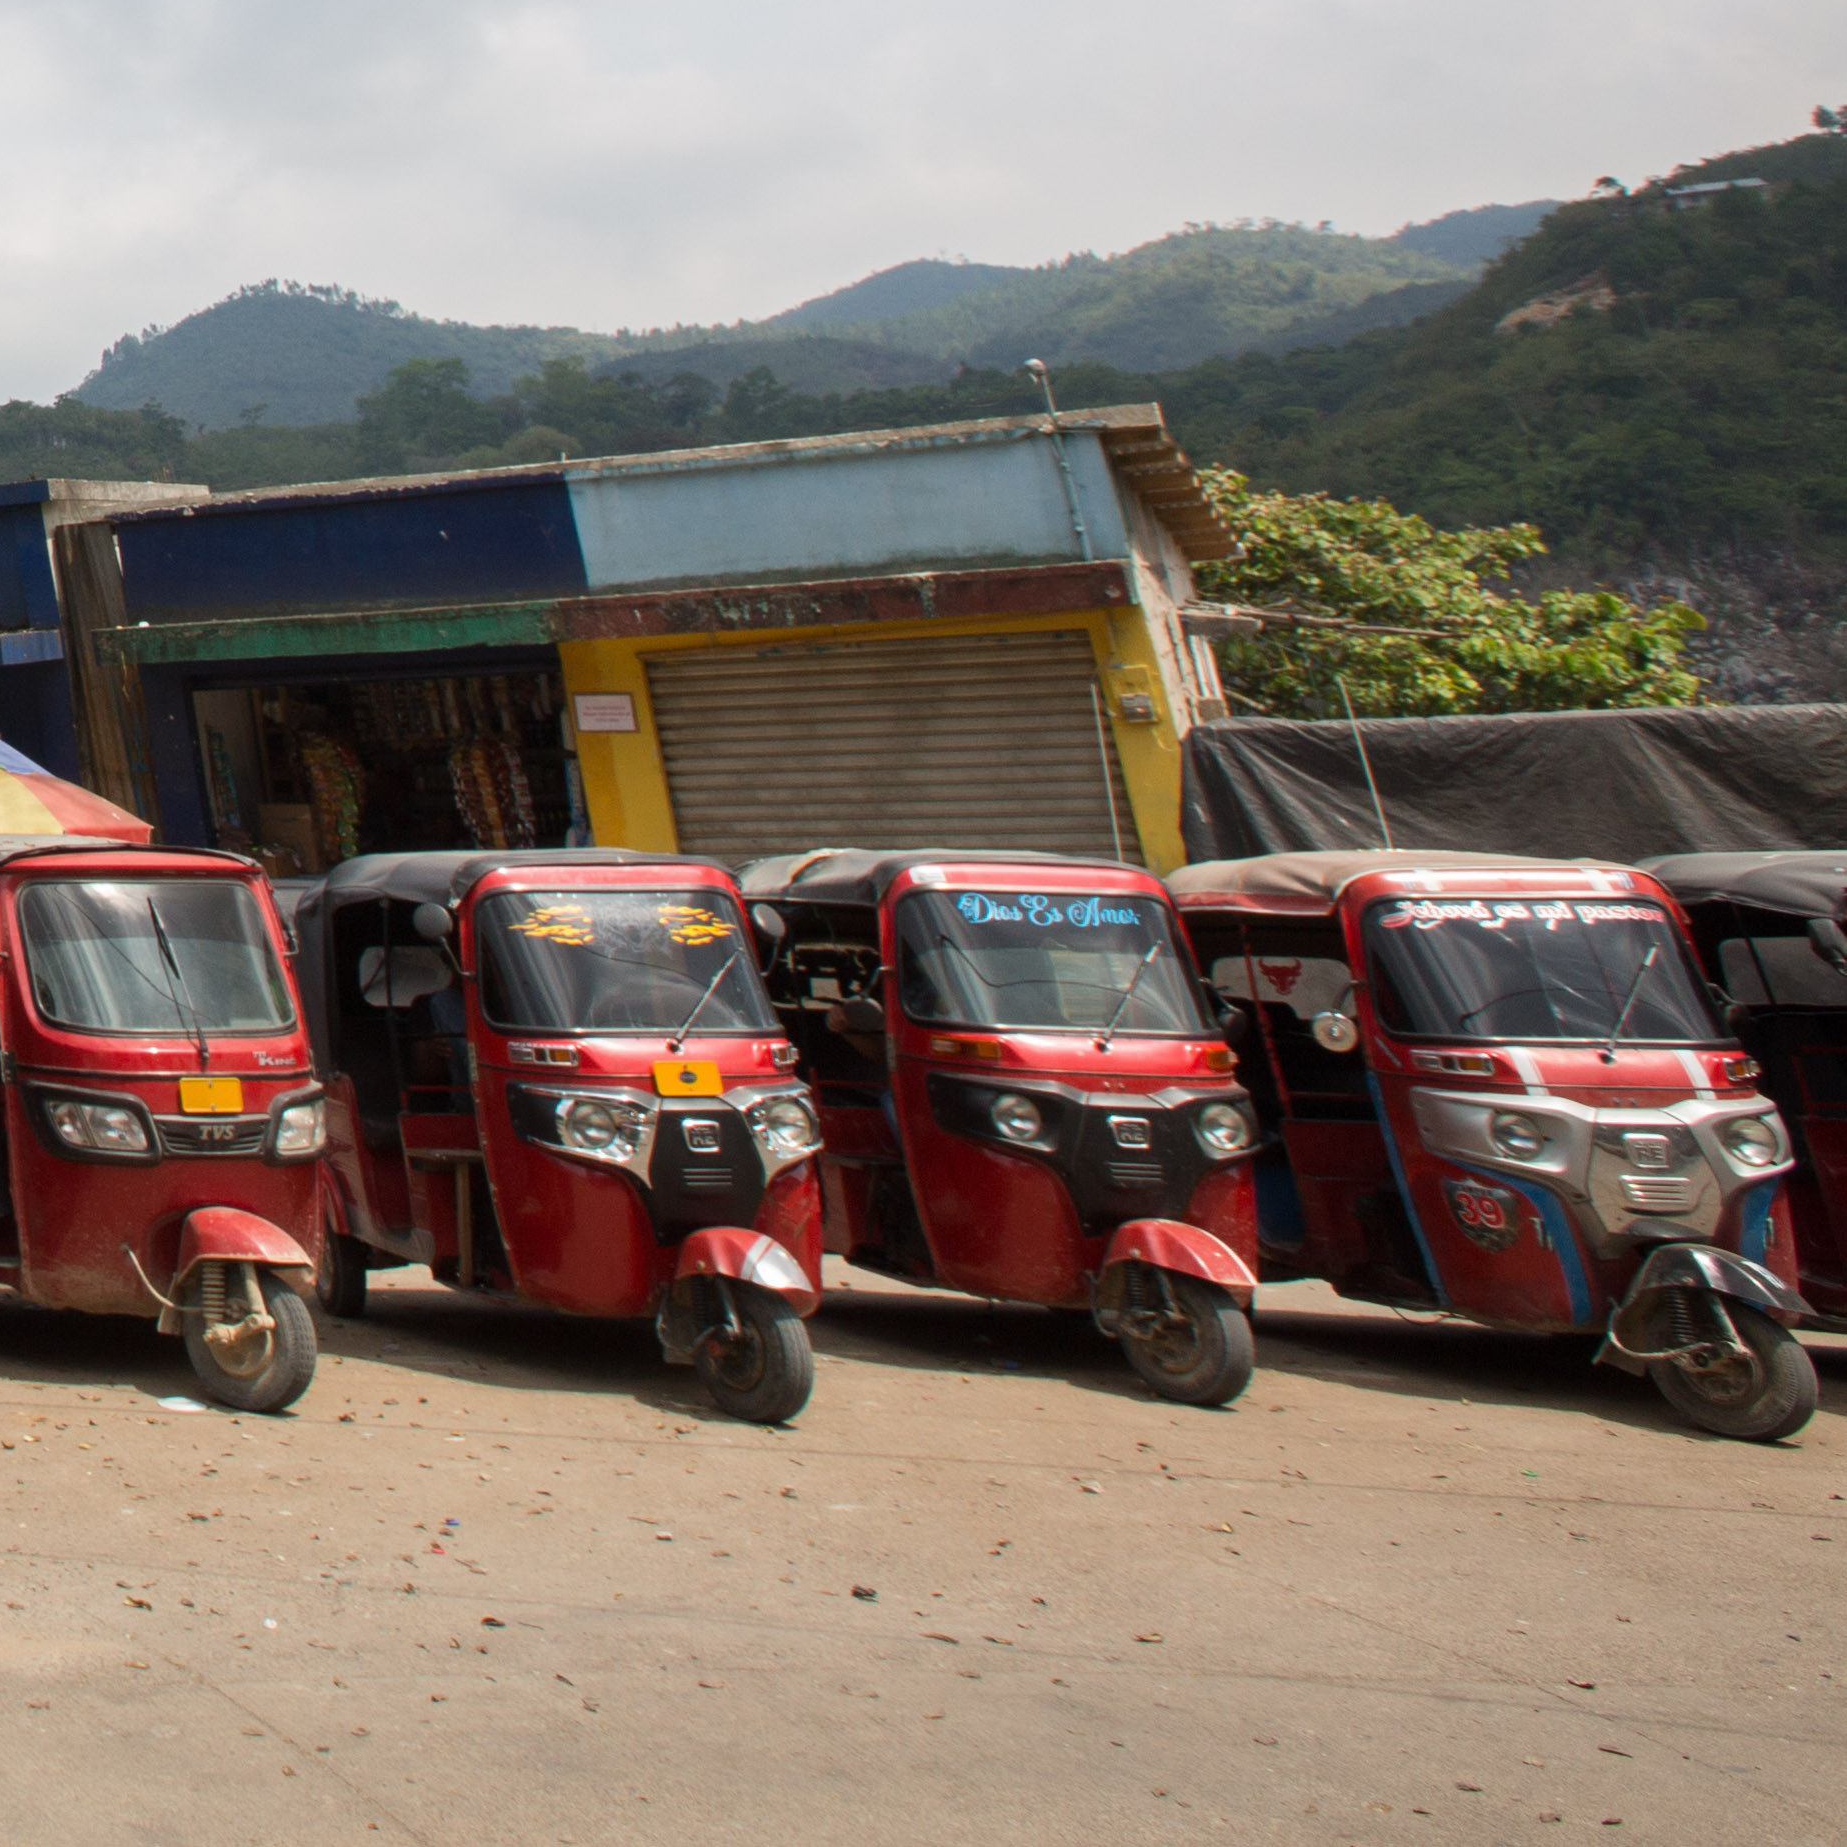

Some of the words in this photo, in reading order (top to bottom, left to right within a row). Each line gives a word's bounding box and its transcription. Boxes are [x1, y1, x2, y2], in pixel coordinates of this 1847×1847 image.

[958, 892, 1023, 924] Dios
[1019, 893, 1064, 926] Es
[199, 1125, 236, 1141] TVS
[1456, 1191, 1505, 1229] 39
